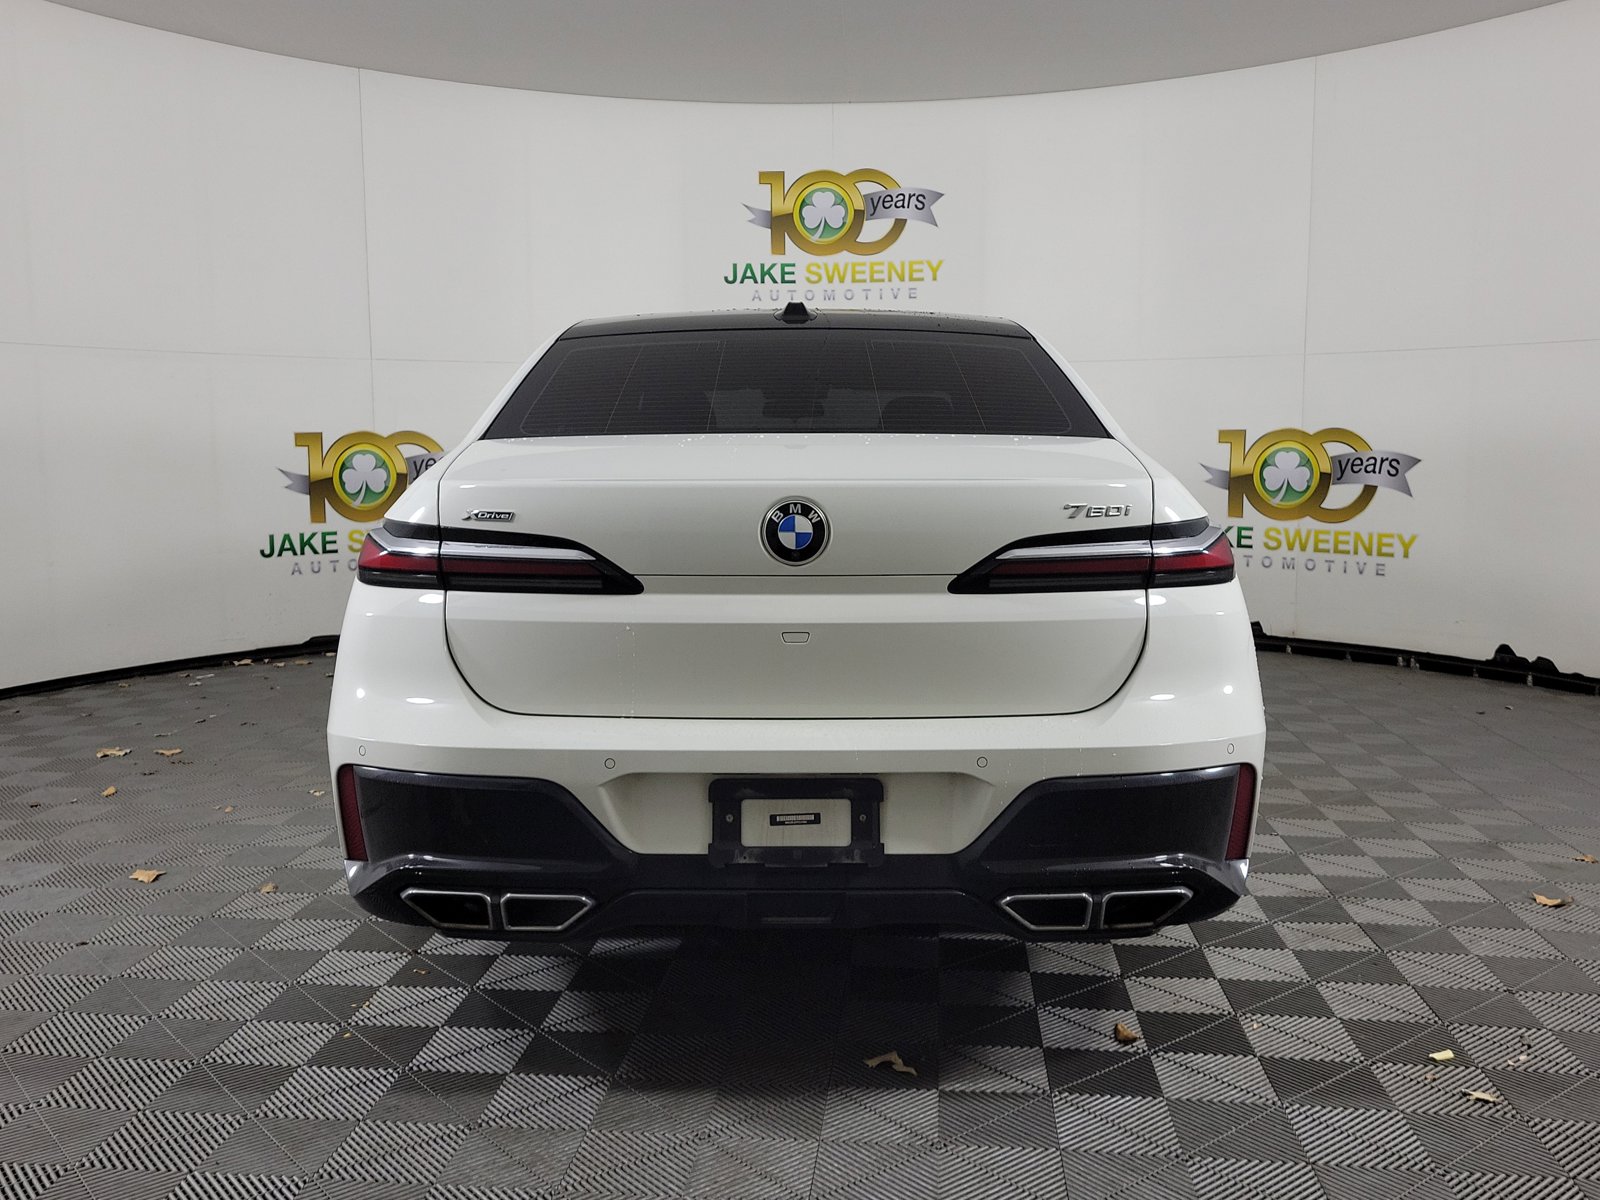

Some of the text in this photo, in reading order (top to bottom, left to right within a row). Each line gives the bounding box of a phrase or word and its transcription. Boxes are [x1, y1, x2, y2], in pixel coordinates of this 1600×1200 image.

[759, 168, 927, 256] 100 years
[723, 259, 944, 285] JAKE SWEENEY
[751, 288, 918, 302] AUTOMOTIVE
[1218, 427, 1401, 524] 100 years
[771, 503, 820, 523] BMW
[1063, 503, 1133, 519] 760i
[259, 531, 339, 558] JAKE
[1263, 525, 1418, 559] SWEENEY
[1243, 554, 1386, 577] TOMOTIVE
